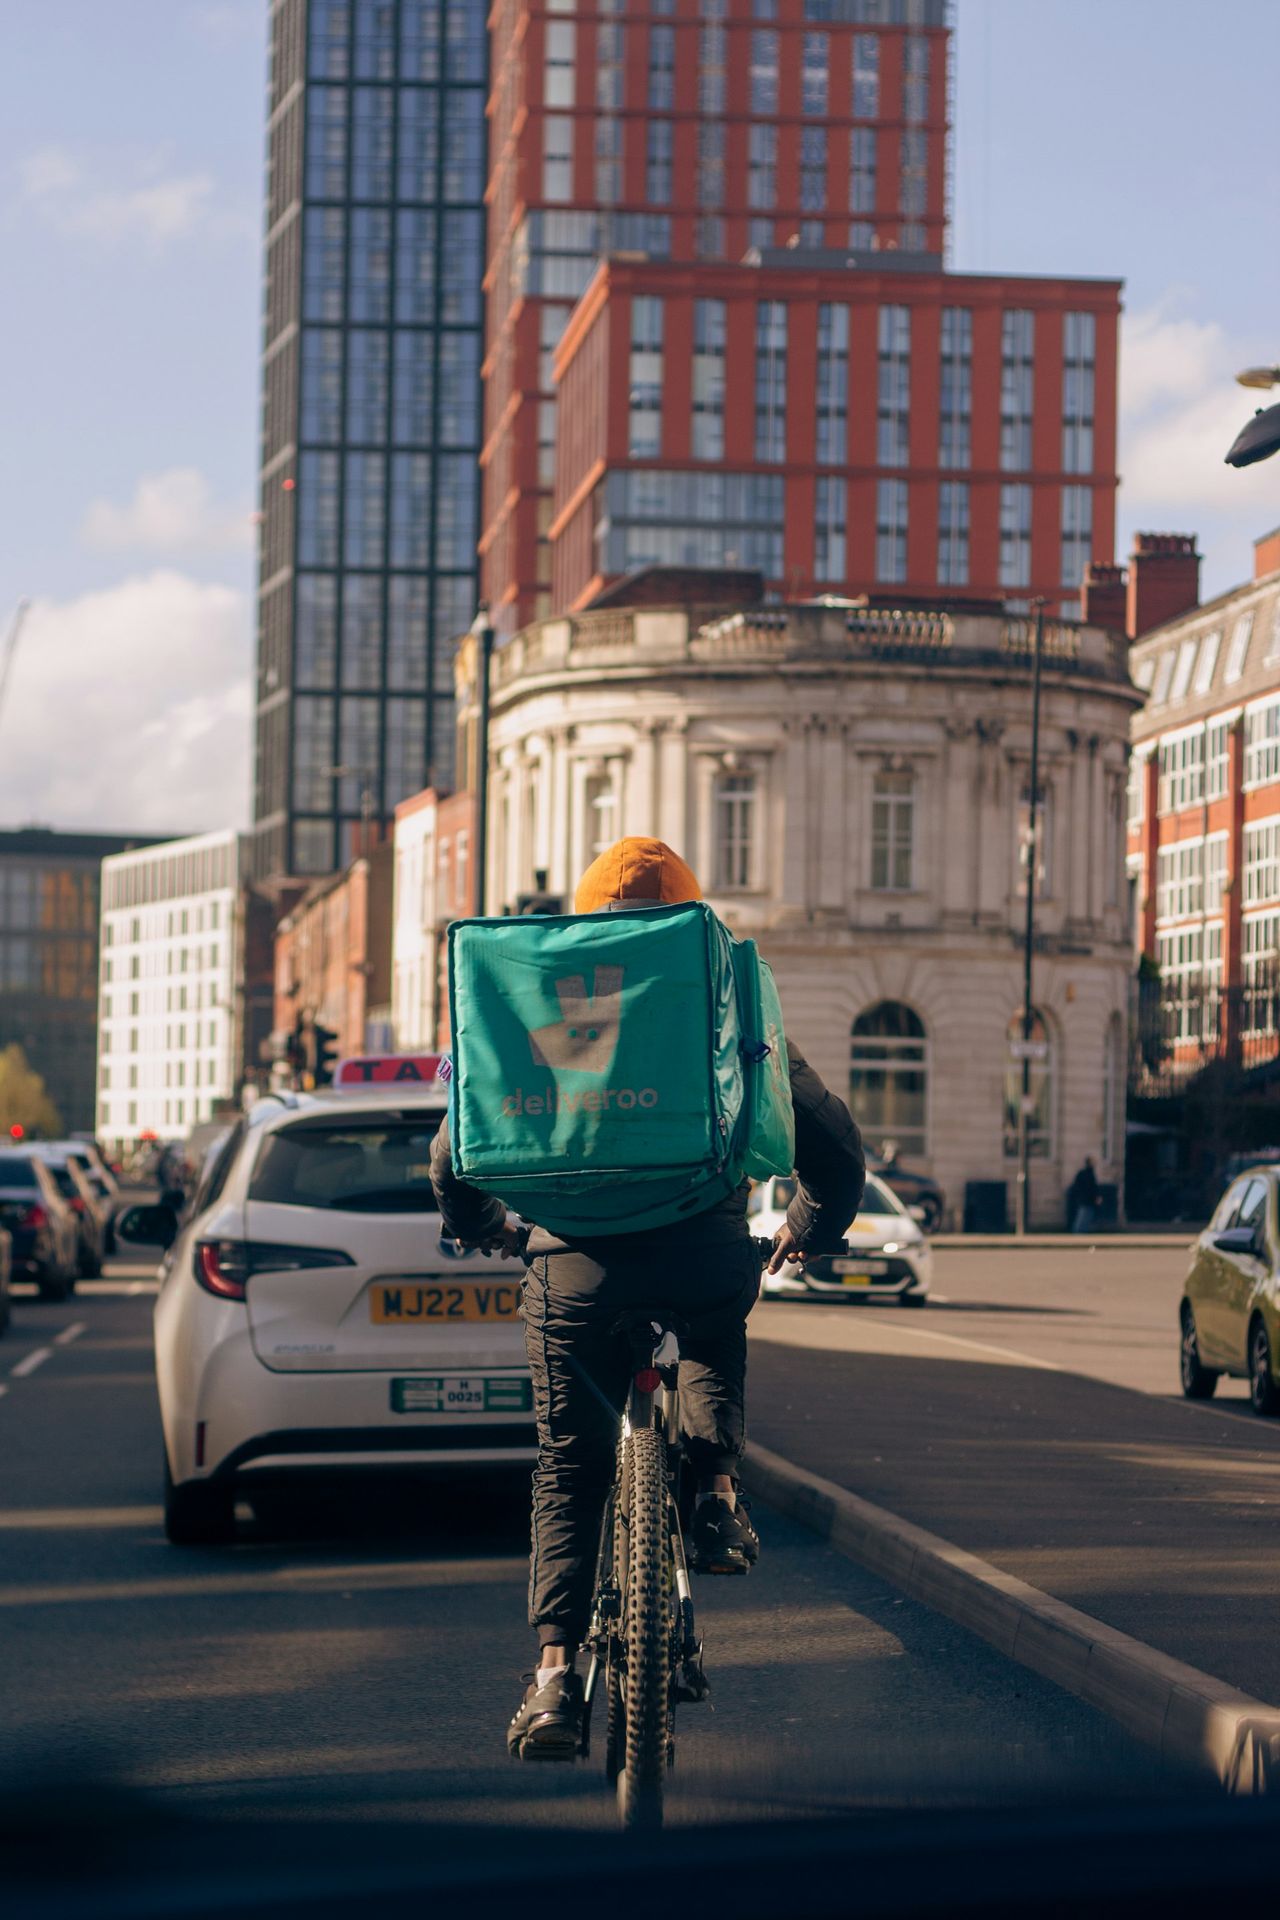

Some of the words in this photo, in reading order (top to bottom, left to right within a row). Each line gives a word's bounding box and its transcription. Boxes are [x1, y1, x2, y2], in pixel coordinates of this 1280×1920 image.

[502, 1087, 659, 1117] deliveroo
[382, 1288, 465, 1317] MJ22
[474, 1287, 524, 1316] VC
